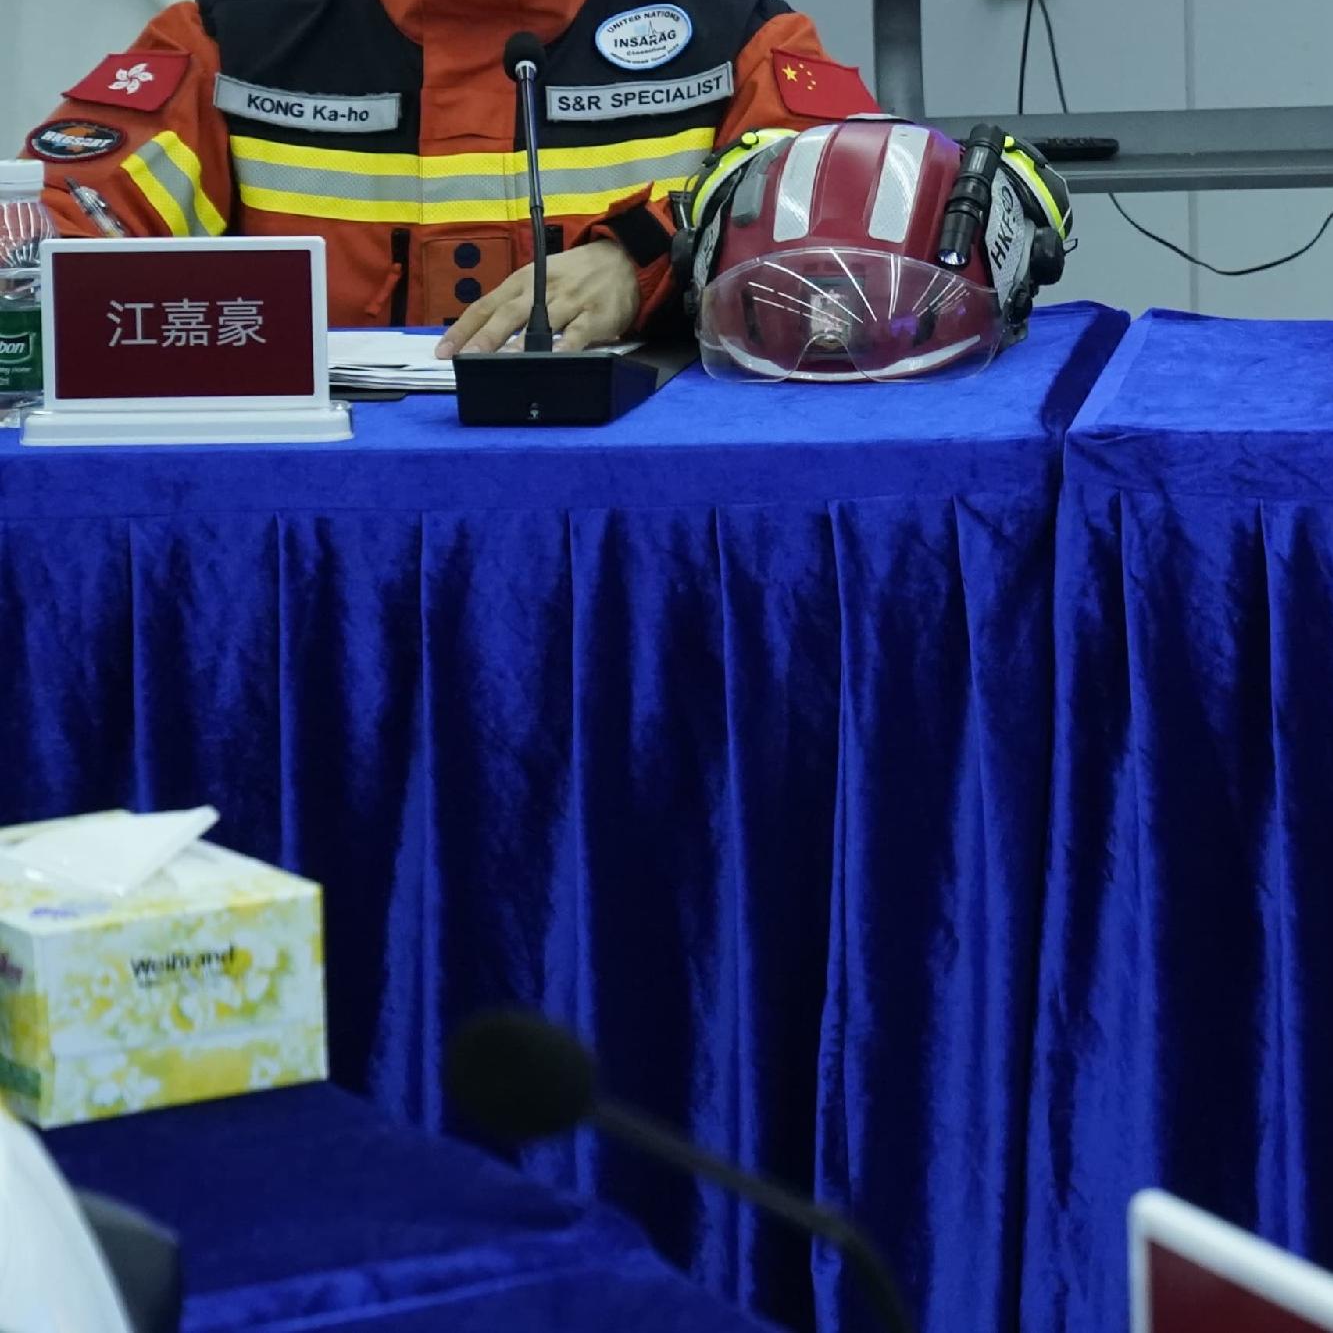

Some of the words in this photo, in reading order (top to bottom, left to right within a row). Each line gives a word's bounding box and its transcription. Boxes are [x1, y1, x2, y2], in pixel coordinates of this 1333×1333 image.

[607, 15, 641, 33] UNITED
[644, 11, 680, 22] NATIONS
[614, 29, 677, 48] INSARAG
[247, 93, 304, 118] KONG
[312, 105, 369, 122] Ka-ho
[558, 95, 601, 111] S&R
[610, 75, 722, 108] SPECIALIST
[106, 297, 267, 347] 江嘉豪
